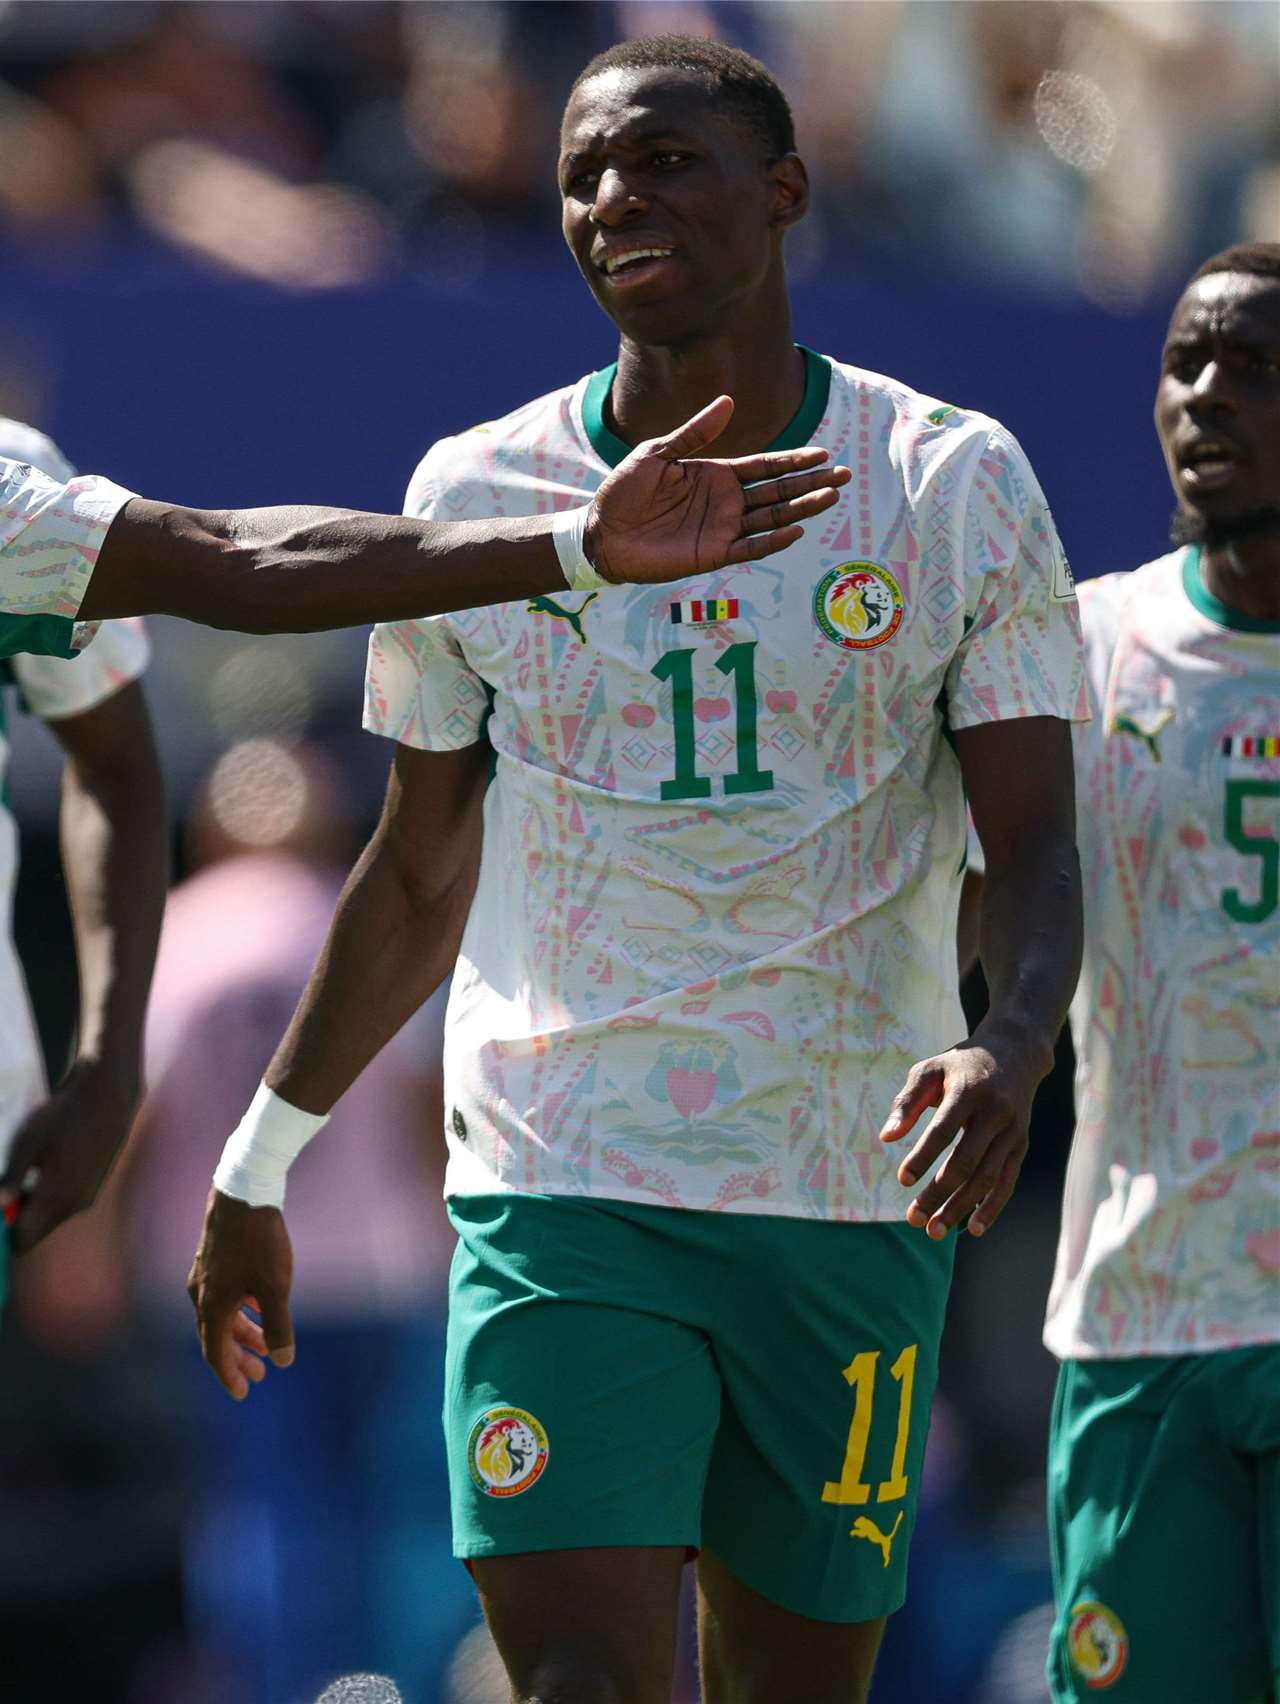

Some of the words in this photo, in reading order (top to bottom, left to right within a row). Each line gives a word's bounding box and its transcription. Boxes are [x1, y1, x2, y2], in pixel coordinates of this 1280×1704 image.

[650, 641, 774, 800] 11
[1222, 779, 1280, 924] 5
[821, 1344, 917, 1505] 11
